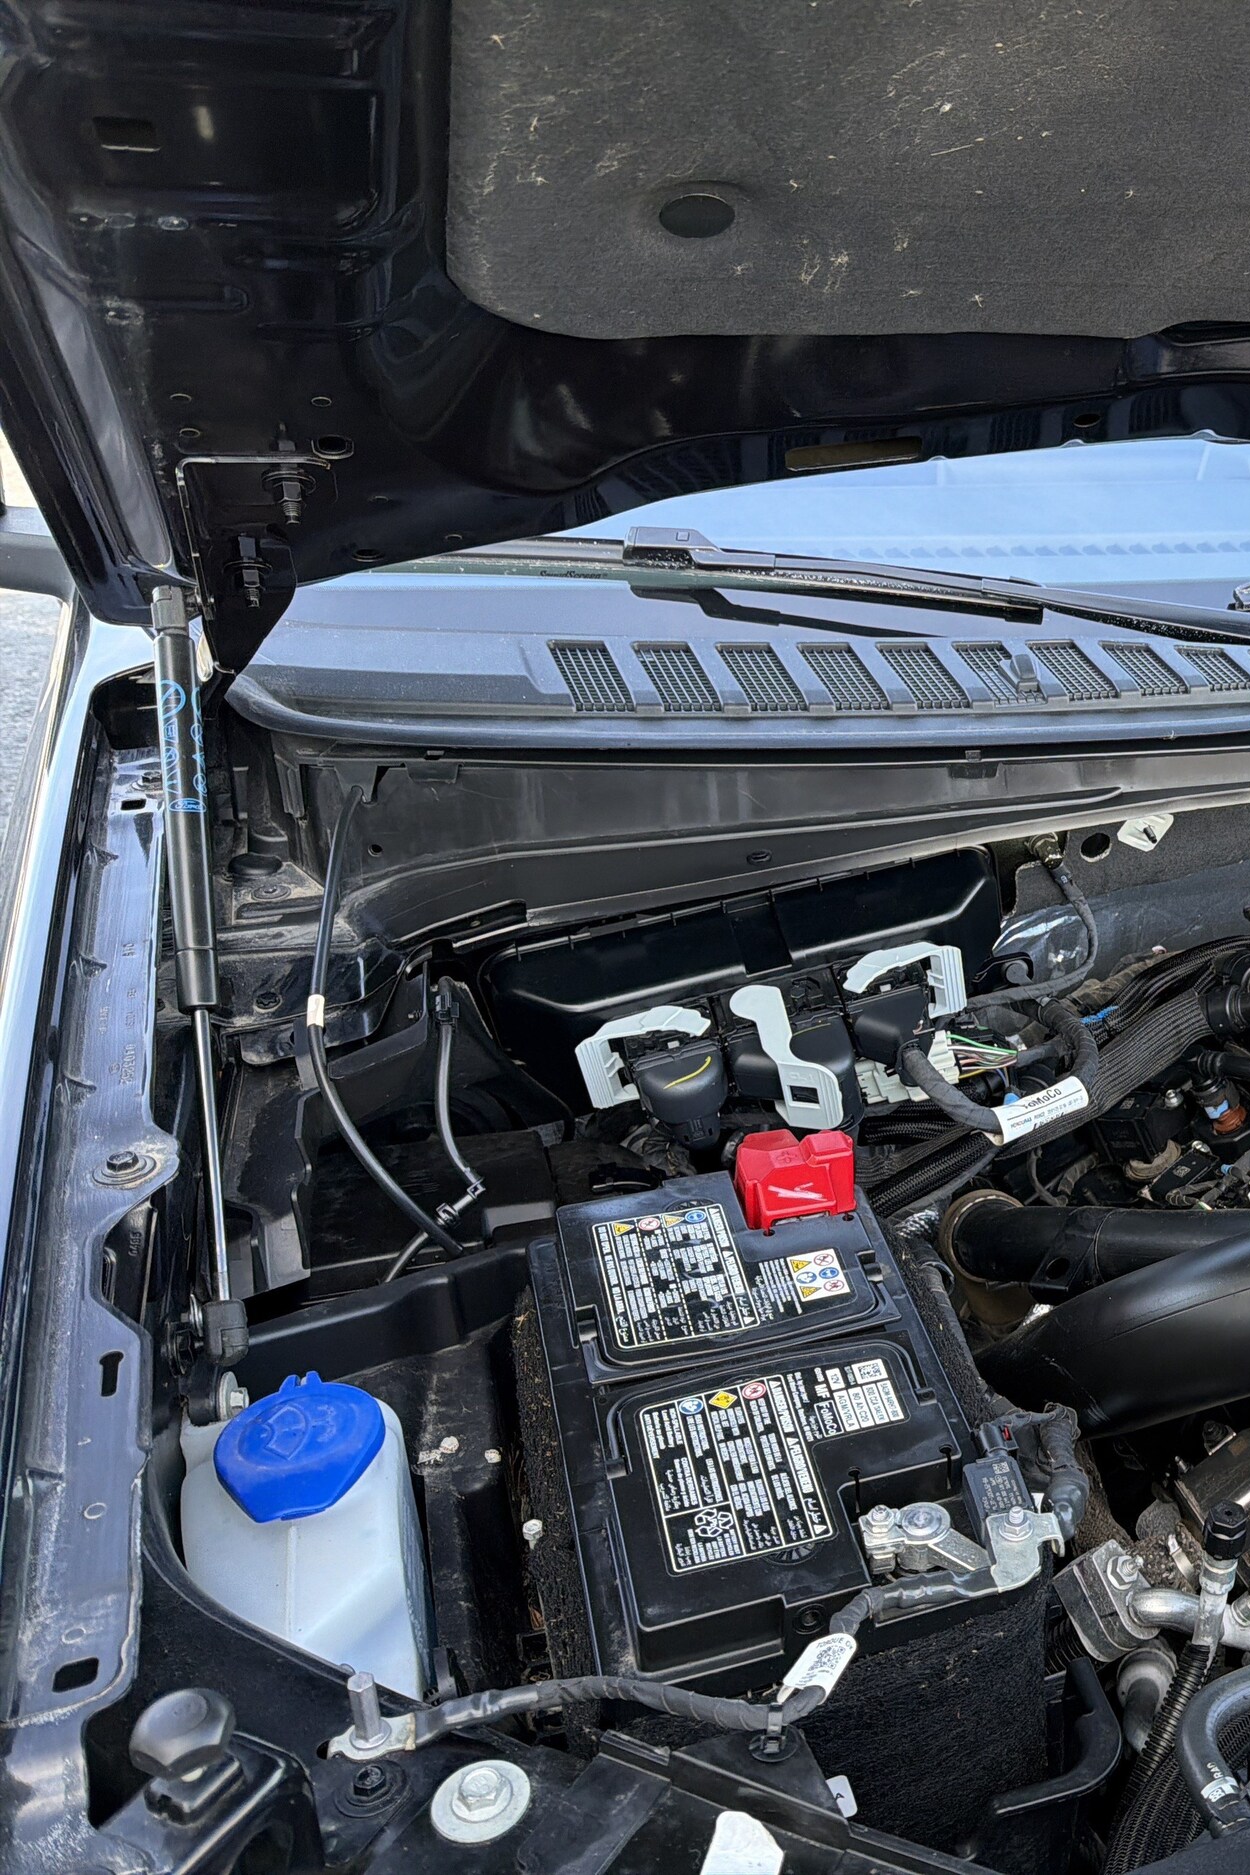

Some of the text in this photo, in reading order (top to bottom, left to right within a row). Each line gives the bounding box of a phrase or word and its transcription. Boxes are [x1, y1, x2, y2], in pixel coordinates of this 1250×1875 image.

[813, 1383, 830, 1399] MF
[830, 1373, 840, 1385] 12V
[818, 1402, 838, 1435] FoMoCo
[836, 1393, 855, 1428] AGM/VRLA
[855, 1401, 865, 1410] Ah
[858, 1409, 869, 1423] C20
[668, 1407, 683, 1445] NON-SPILLABLE
[770, 1386, 795, 1433] DANGER/POISON
[788, 1443, 814, 1494] PELIGRO/VENENO
[684, 1476, 698, 1506] DERRAMES
